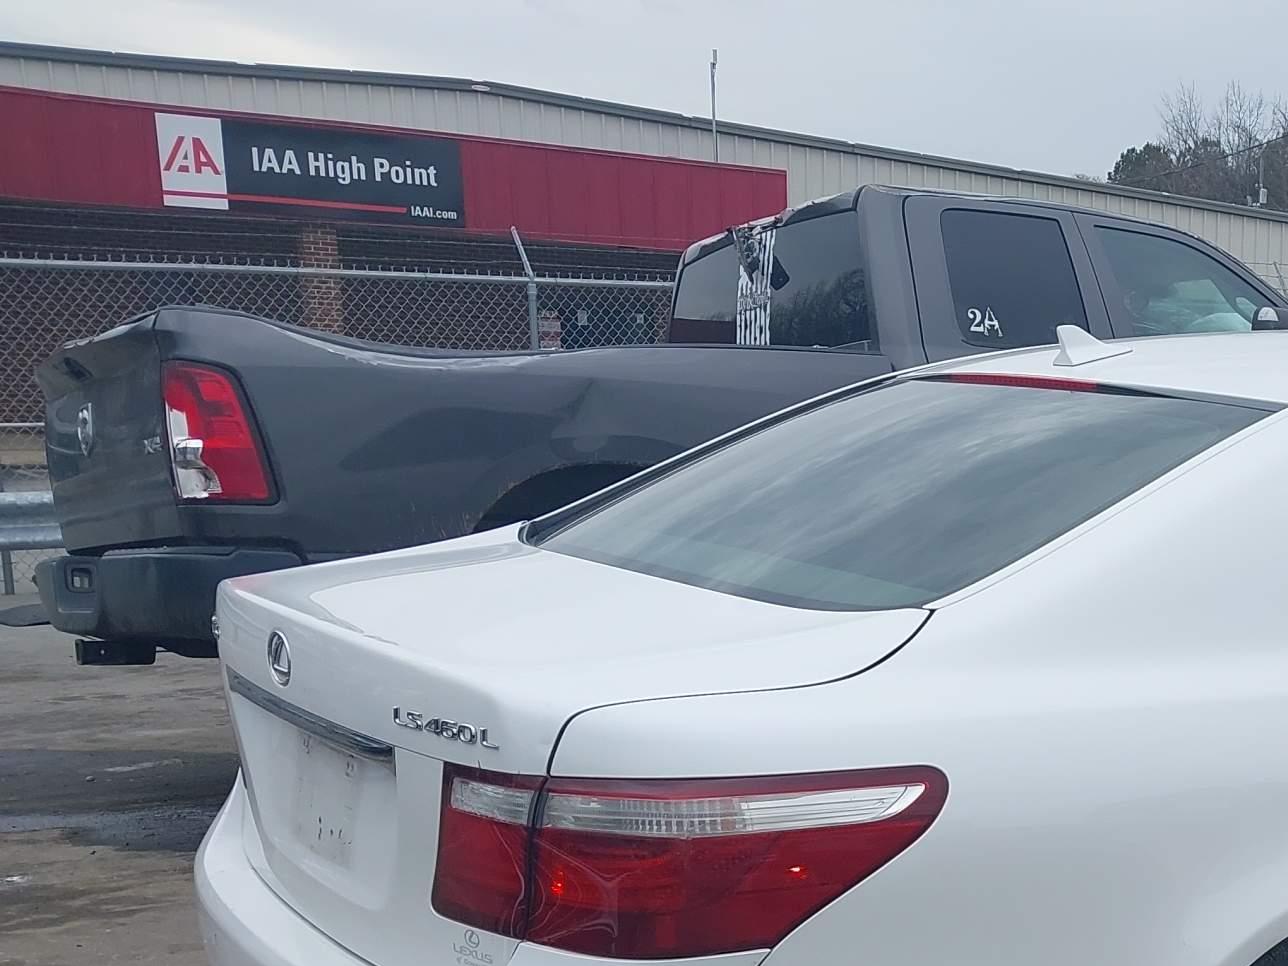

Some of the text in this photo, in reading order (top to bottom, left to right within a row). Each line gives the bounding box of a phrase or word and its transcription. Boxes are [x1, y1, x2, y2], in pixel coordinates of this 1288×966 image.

[251, 146, 438, 187] IAA High Point
[410, 205, 458, 220] IAAI.com
[967, 306, 1003, 337] 2A
[452, 941, 494, 965] LEXUS
